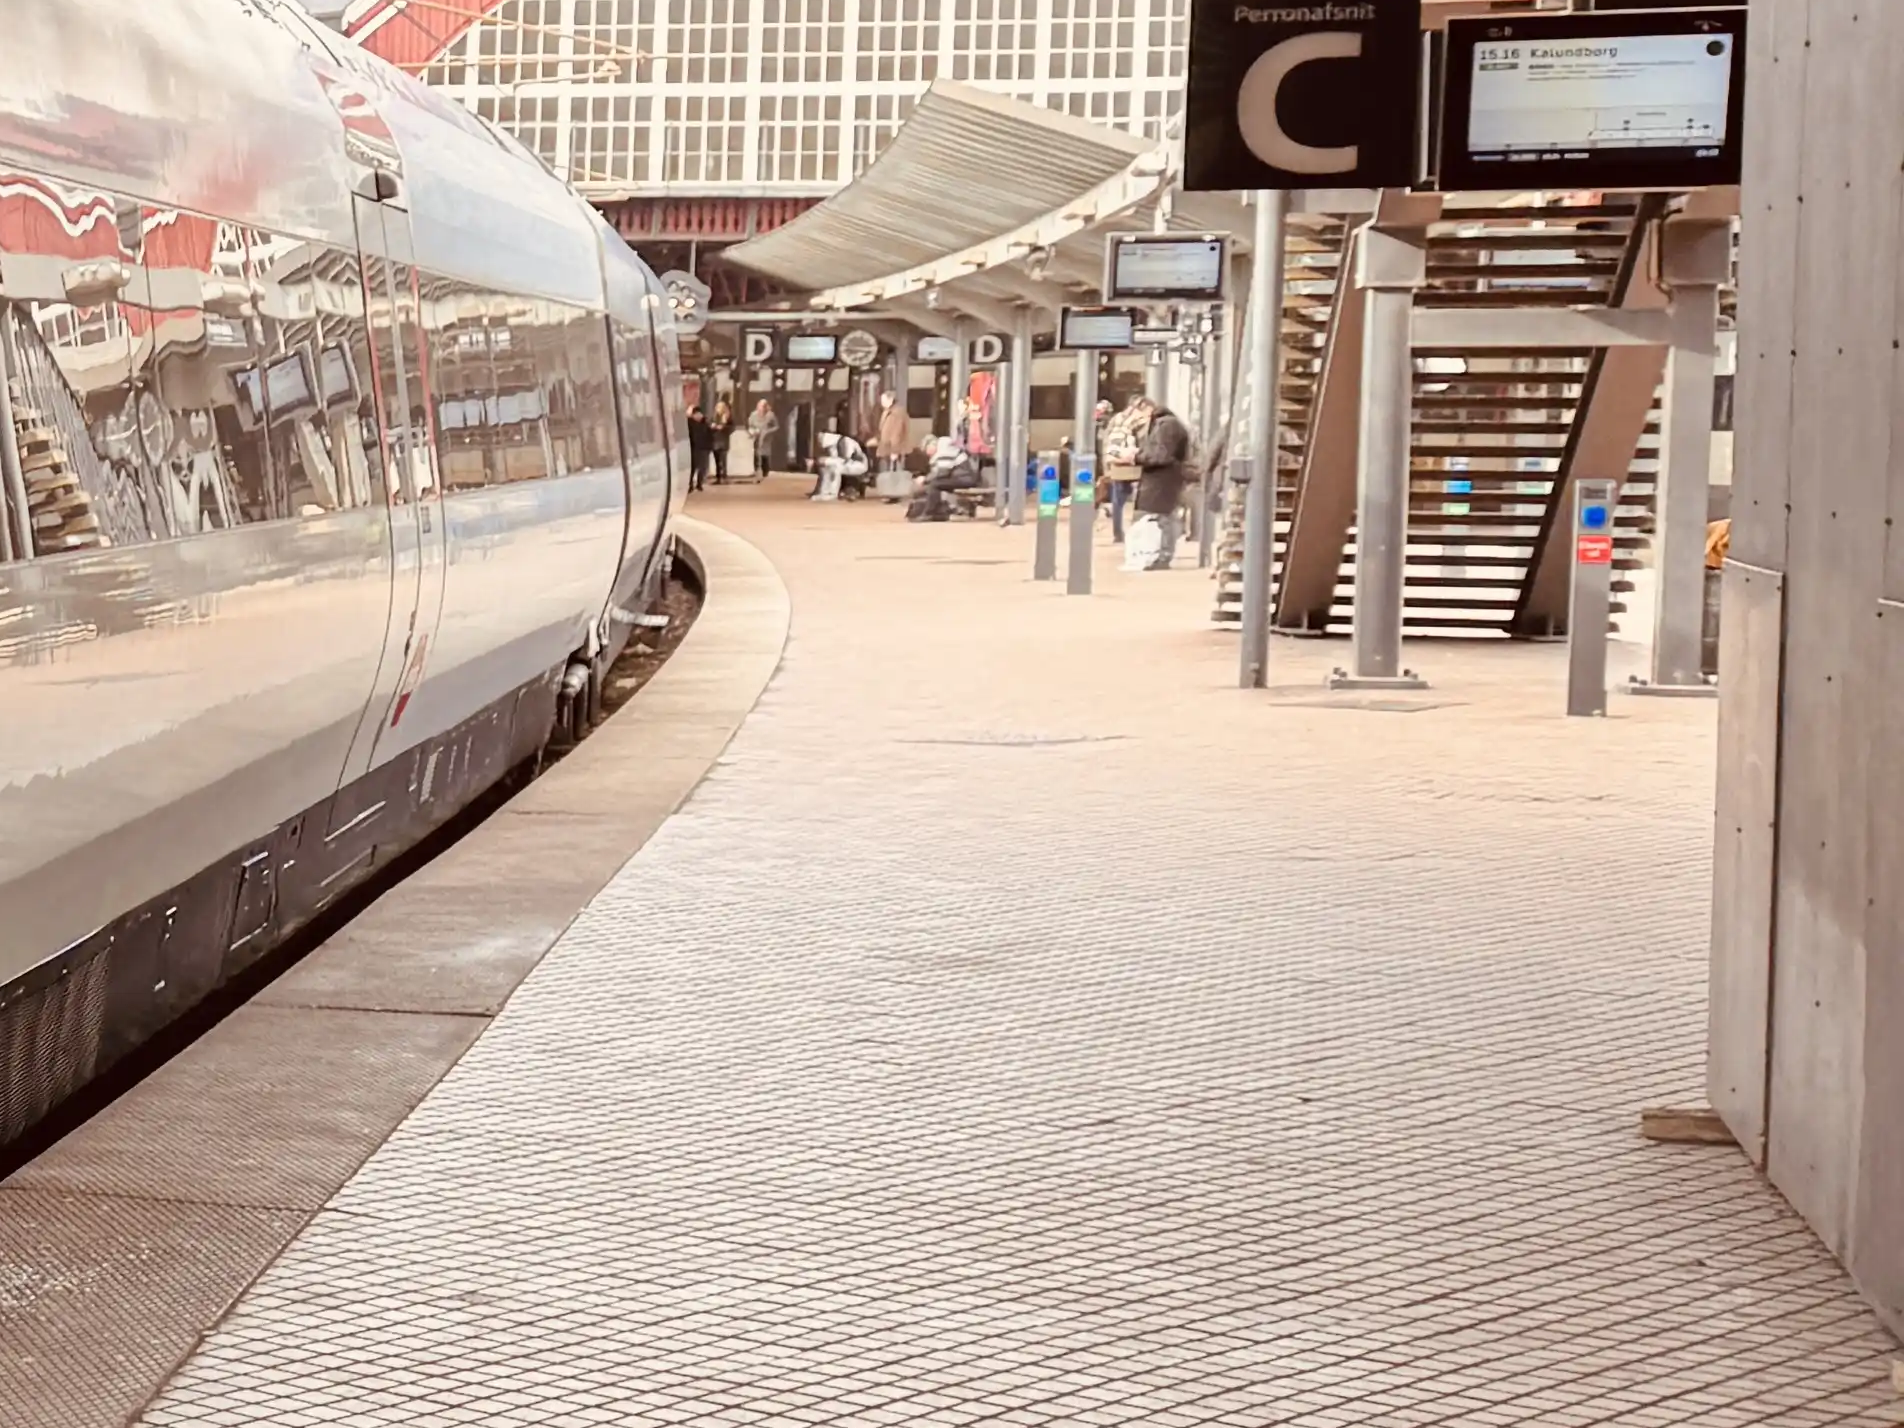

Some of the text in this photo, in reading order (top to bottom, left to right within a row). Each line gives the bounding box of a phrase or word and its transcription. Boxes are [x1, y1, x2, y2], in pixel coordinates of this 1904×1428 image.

[1234, 2, 1376, 22] Perronafsnit
[1237, 31, 1363, 174] C
[745, 334, 773, 362] D
[974, 334, 1003, 363] D
